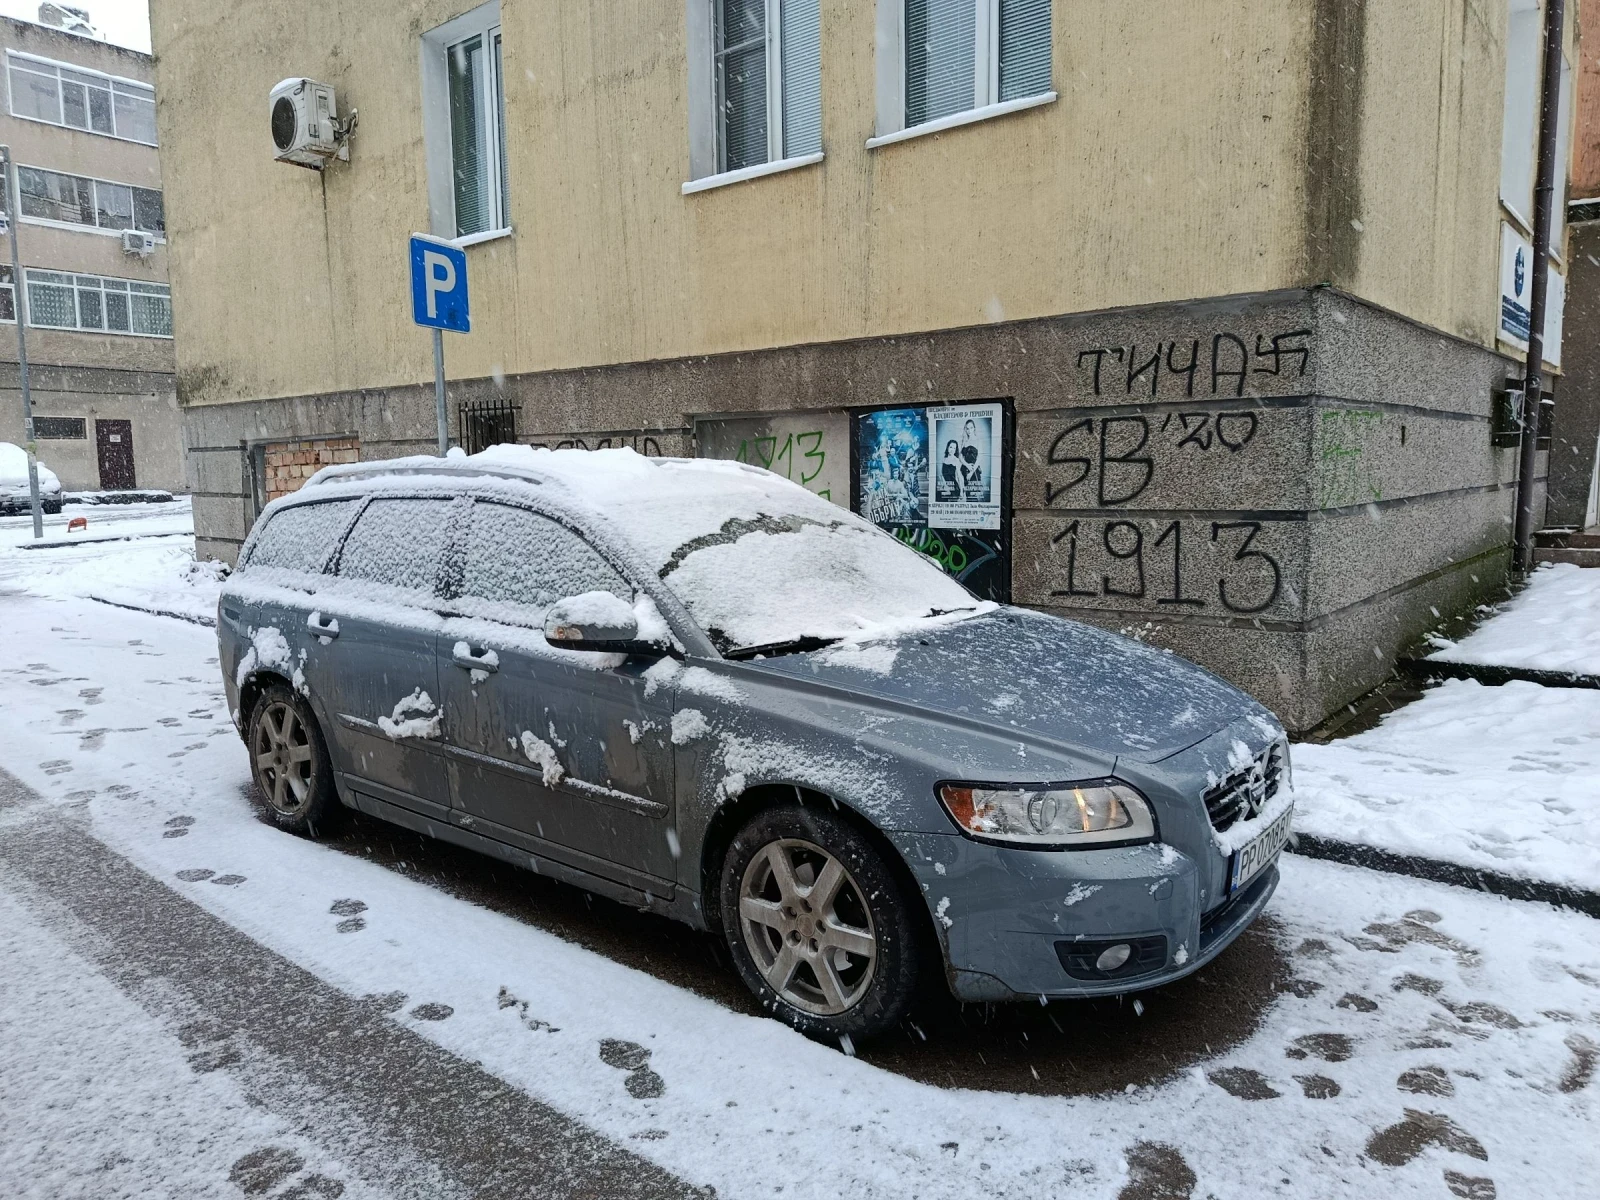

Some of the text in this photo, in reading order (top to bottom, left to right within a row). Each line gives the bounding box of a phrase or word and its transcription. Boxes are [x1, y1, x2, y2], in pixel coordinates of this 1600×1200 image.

[424, 250, 456, 319] P
[1077, 332, 1248, 396] ТИЧА
[1050, 520, 1281, 614] 1913
